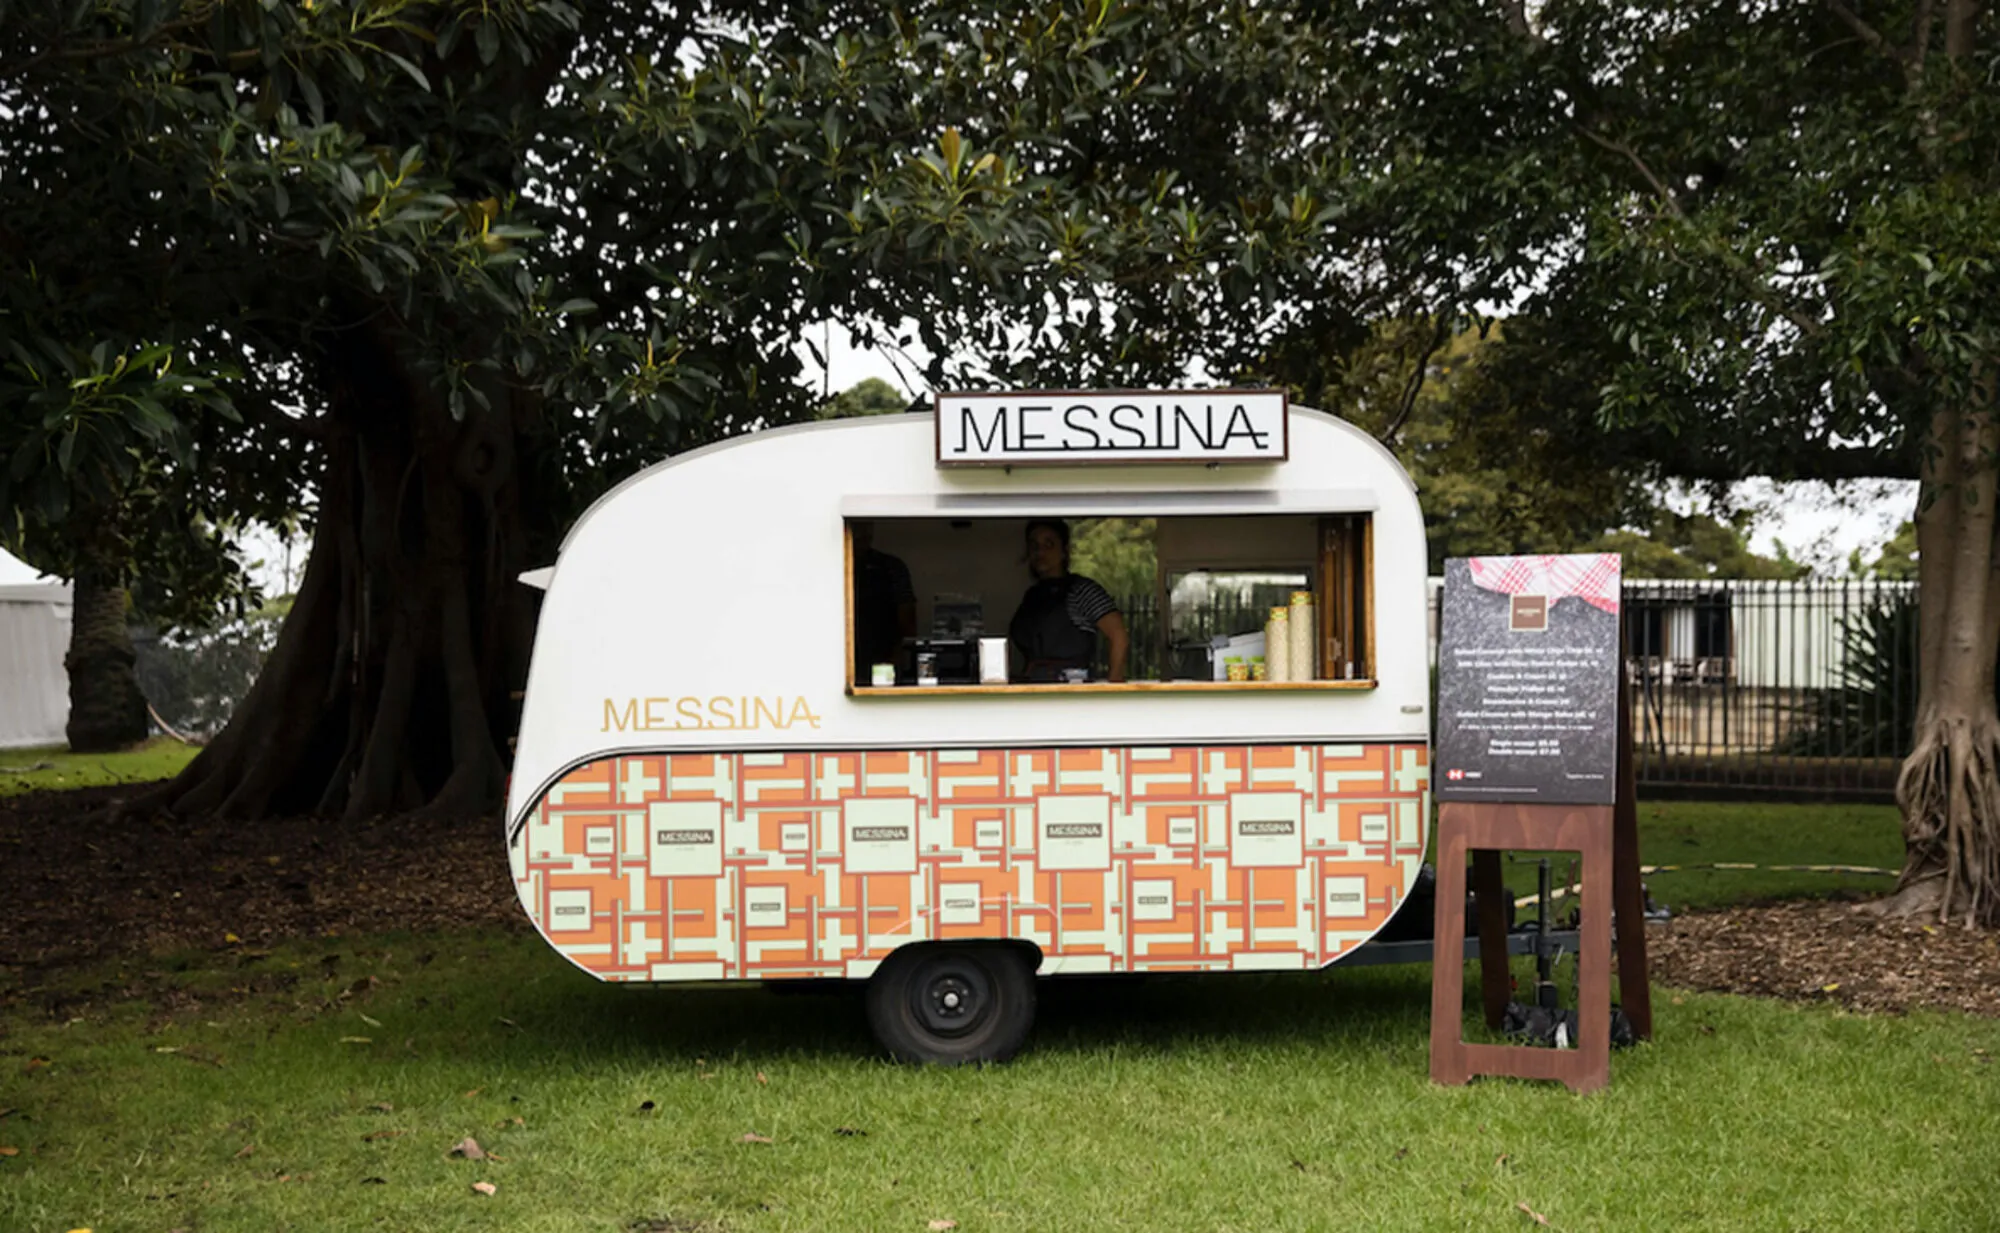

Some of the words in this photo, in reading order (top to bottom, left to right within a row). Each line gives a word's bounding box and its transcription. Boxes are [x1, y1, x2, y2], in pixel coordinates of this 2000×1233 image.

[954, 405, 1269, 452] MESSINA
[601, 696, 821, 732] MESSINA
[1049, 825, 1101, 836] MESSINA
[1242, 822, 1293, 833] MESSINA
[660, 831, 713, 842] MESSINA
[855, 828, 907, 839] MESSINA
